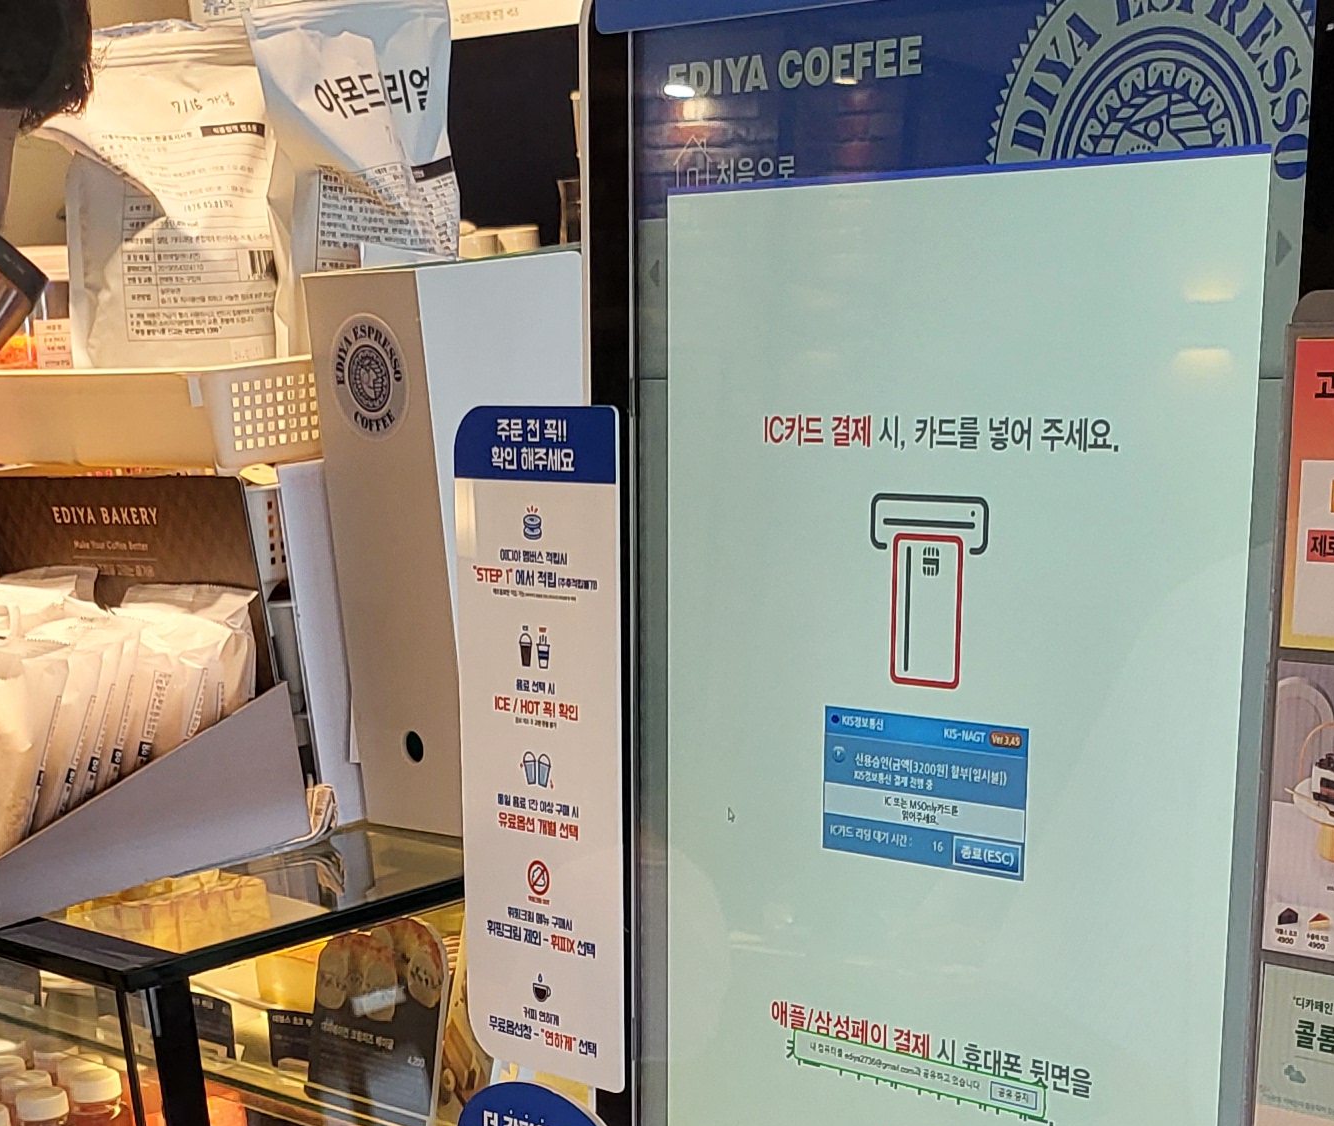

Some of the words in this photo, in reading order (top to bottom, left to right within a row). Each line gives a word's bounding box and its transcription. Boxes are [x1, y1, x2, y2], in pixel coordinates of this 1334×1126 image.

[666, 53, 768, 98] EDIYA
[777, 35, 923, 89] COFFEE
[336, 336, 352, 385] EDIYA
[352, 325, 402, 382] ESPRESSO
[354, 409, 395, 432] COFFEE
[497, 419, 524, 442] 주문
[527, 419, 539, 442] 전
[544, 420, 566, 442] 꼭!!
[764, 414, 824, 448] IC카드
[831, 415, 871, 448] 결제
[878, 416, 906, 451] 시,
[914, 416, 980, 449] 카드를
[989, 417, 1032, 451] 넣어
[1040, 417, 1119, 452] 주세요.
[491, 447, 517, 469] 확인
[521, 447, 575, 471] 해주세요
[51, 506, 96, 524] EDIYA
[100, 507, 157, 525] BAKERY
[500, 549, 521, 561] 이디야
[516, 570, 534, 587] 에서
[538, 571, 556, 587] 적립
[516, 679, 530, 692] 음료
[532, 680, 545, 694] 선택
[548, 683, 555, 695] 시
[494, 696, 510, 712] ICE
[520, 699, 540, 715] HOT
[543, 701, 556, 718] 꼭!
[559, 704, 578, 721] 확인
[842, 715, 884, 731] KIS정보통신
[944, 728, 986, 743] KIS-NAGT
[513, 796, 527, 809] 음료
[540, 800, 554, 814] 이상
[556, 803, 570, 816] 구매
[572, 806, 579, 818] 시
[884, 797, 891, 806] IC
[893, 798, 908, 809] 또는
[498, 812, 535, 832] 유료옵션
[538, 818, 556, 837] 개별
[559, 822, 579, 841] 선택
[873, 830, 889, 843] 대기
[891, 834, 907, 848] 시간
[932, 841, 943, 852] 16
[961, 846, 1015, 866] 종료(ESC)
[536, 912, 549, 926] 메뉴
[487, 920, 521, 941] 휘핑크림
[524, 928, 541, 946] 제외
[577, 940, 595, 958] 선택
[1277, 936, 1294, 945] 4900
[1308, 942, 1325, 950] 4900
[523, 1006, 537, 1020] 커피
[539, 1011, 560, 1026] 연하게
[489, 1015, 532, 1040] 무료옵션창
[579, 1040, 597, 1058] 선택
[771, 1001, 888, 1050] 애플/삼성페이
[893, 1027, 930, 1060] 결제
[937, 1038, 956, 1065] 시
[962, 1044, 1023, 1080] 휴대폰
[1029, 1057, 1092, 1099] 뒷면을
